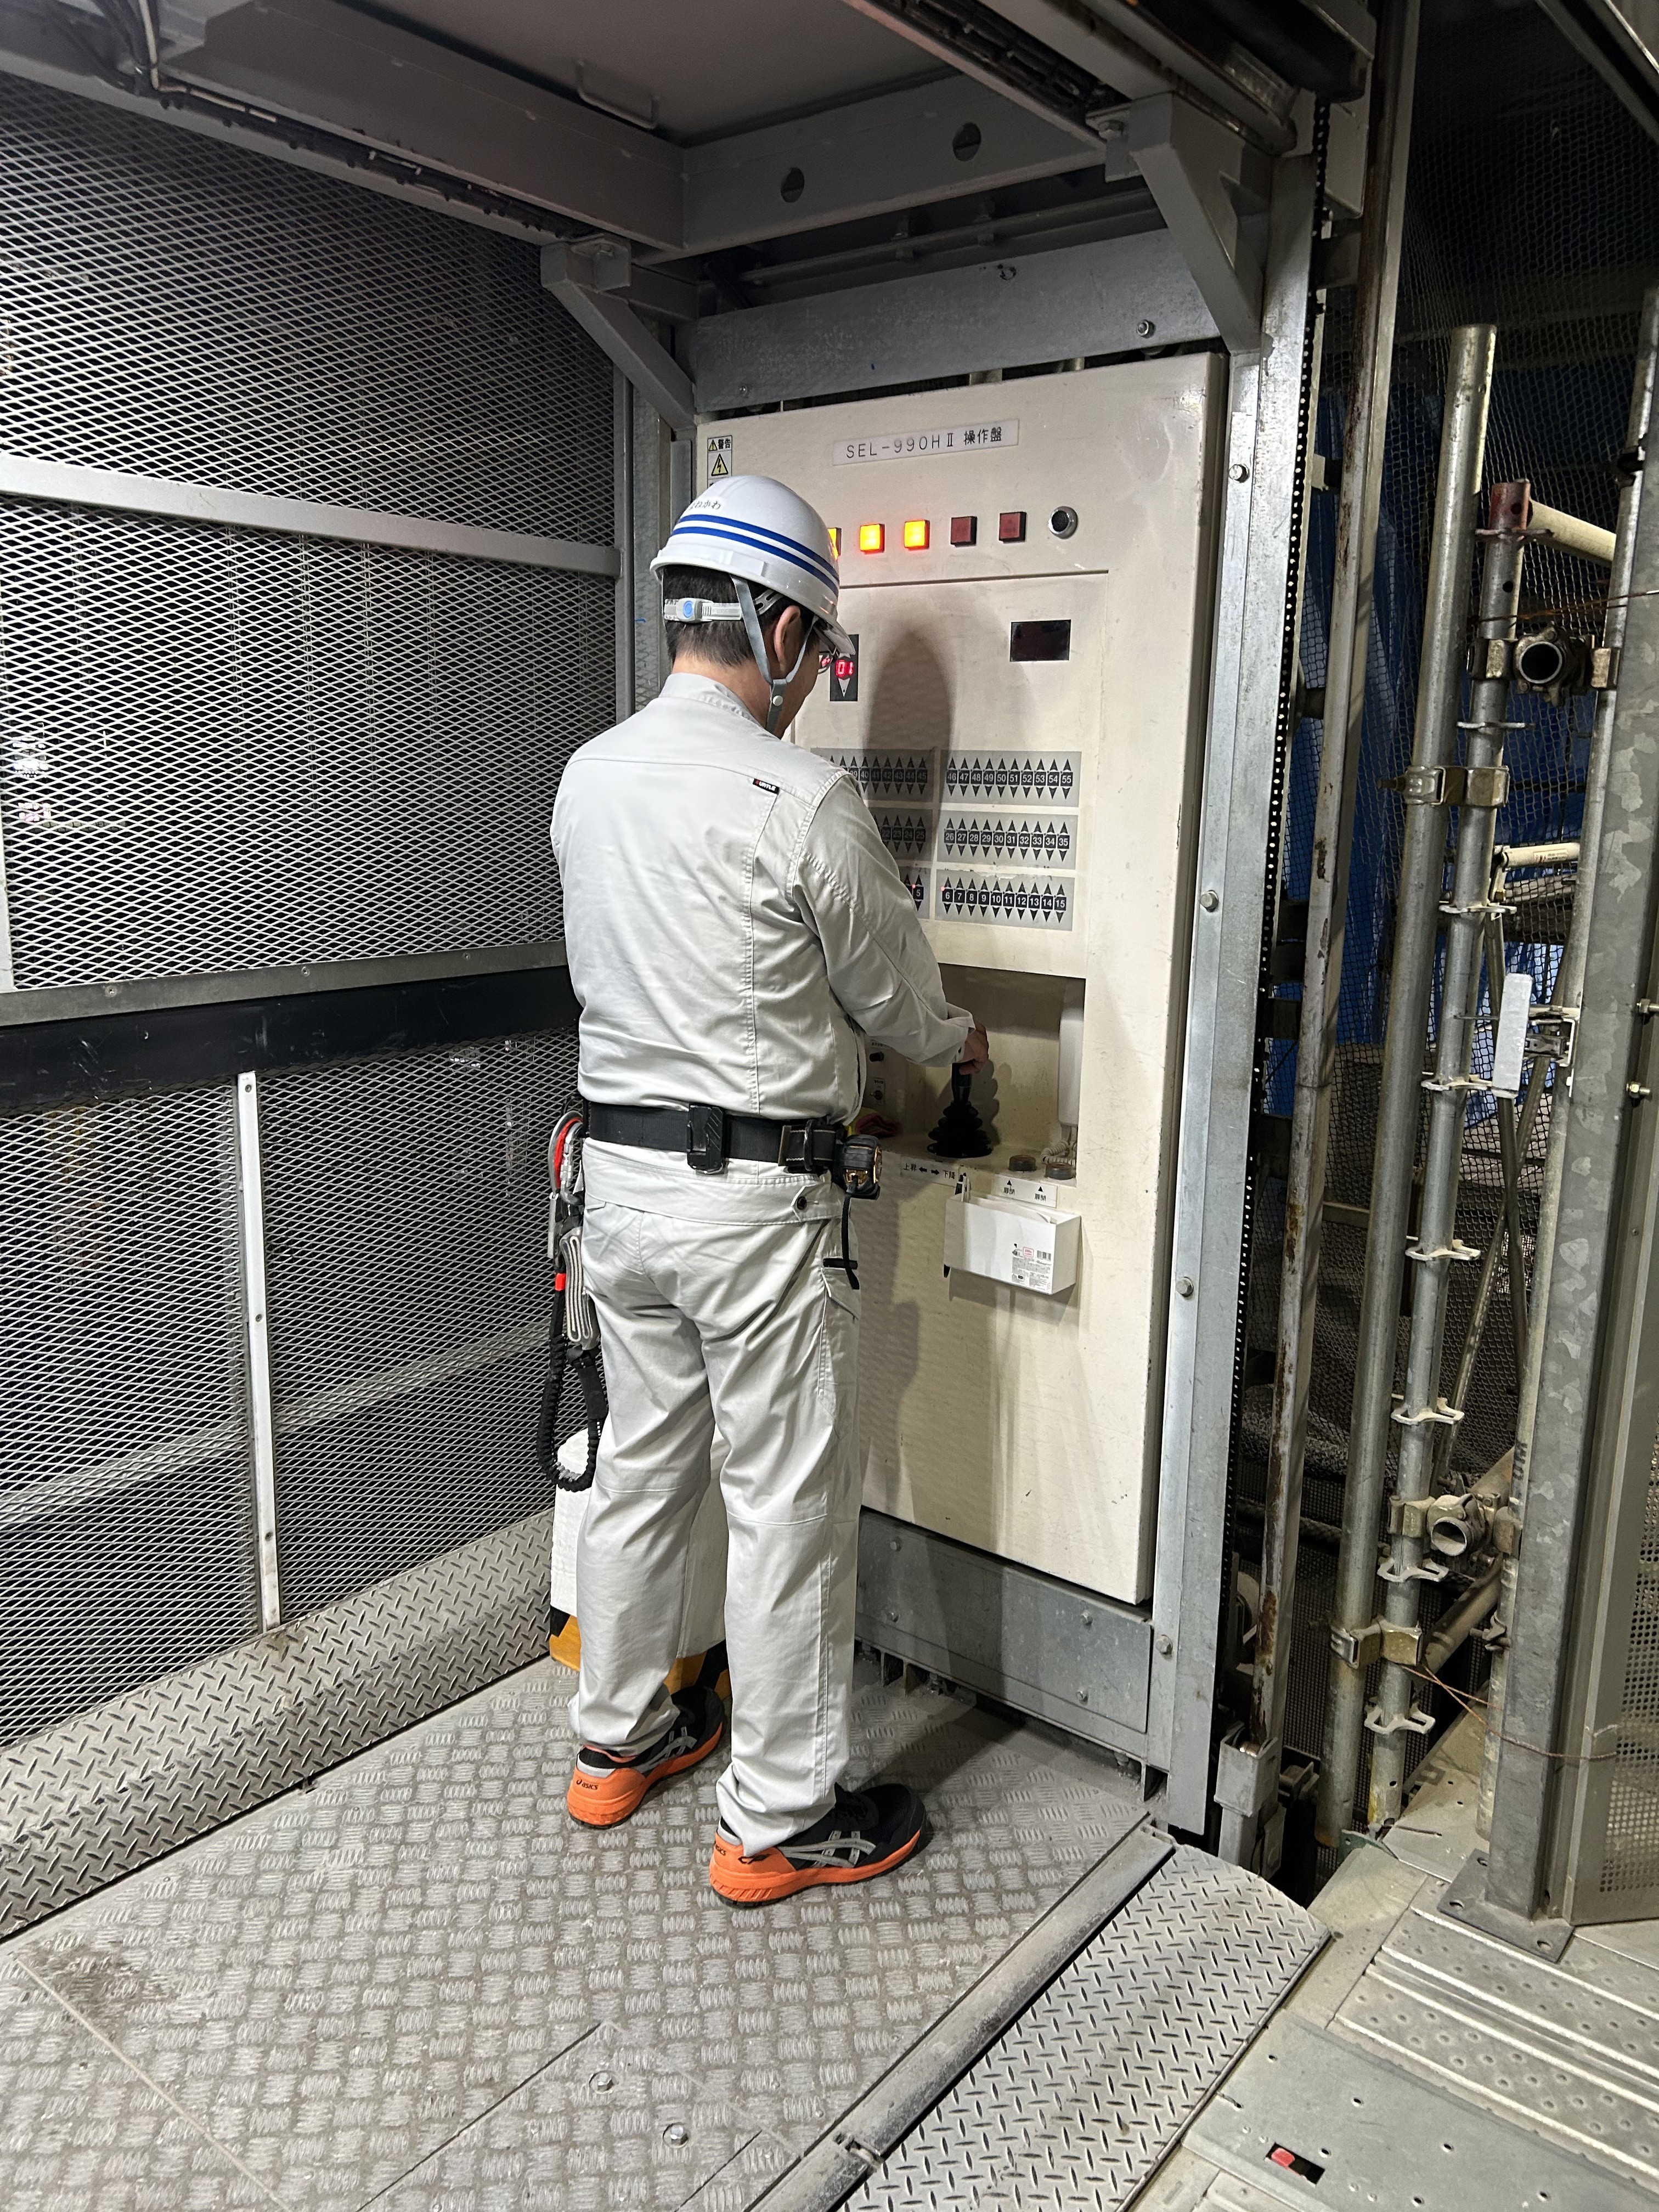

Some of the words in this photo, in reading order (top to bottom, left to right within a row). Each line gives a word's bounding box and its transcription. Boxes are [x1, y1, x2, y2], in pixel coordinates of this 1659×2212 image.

[963, 427, 1002, 445] 操作盤
[718, 438, 731, 449] 警告
[947, 772, 956, 781] 46
[984, 774, 994, 782] 49
[997, 774, 1006, 782] 50
[1023, 775, 1032, 783] 52
[1036, 775, 1045, 783] 53
[1048, 775, 1058, 783] 54
[982, 834, 991, 843] 29
[994, 835, 1003, 843] 30
[1007, 836, 1015, 844] 31
[1020, 836, 1029, 844] 32
[1032, 837, 1042, 845] 33
[1046, 837, 1055, 846] 34
[1059, 838, 1068, 846] 35
[916, 889, 921, 897] 5
[1017, 897, 1026, 905] 12
[1030, 898, 1039, 906] 13
[1043, 899, 1052, 907] 14
[1056, 899, 1065, 908] 15
[942, 1169, 955, 1180] 下降
[582, 1782, 599, 1790] asics
